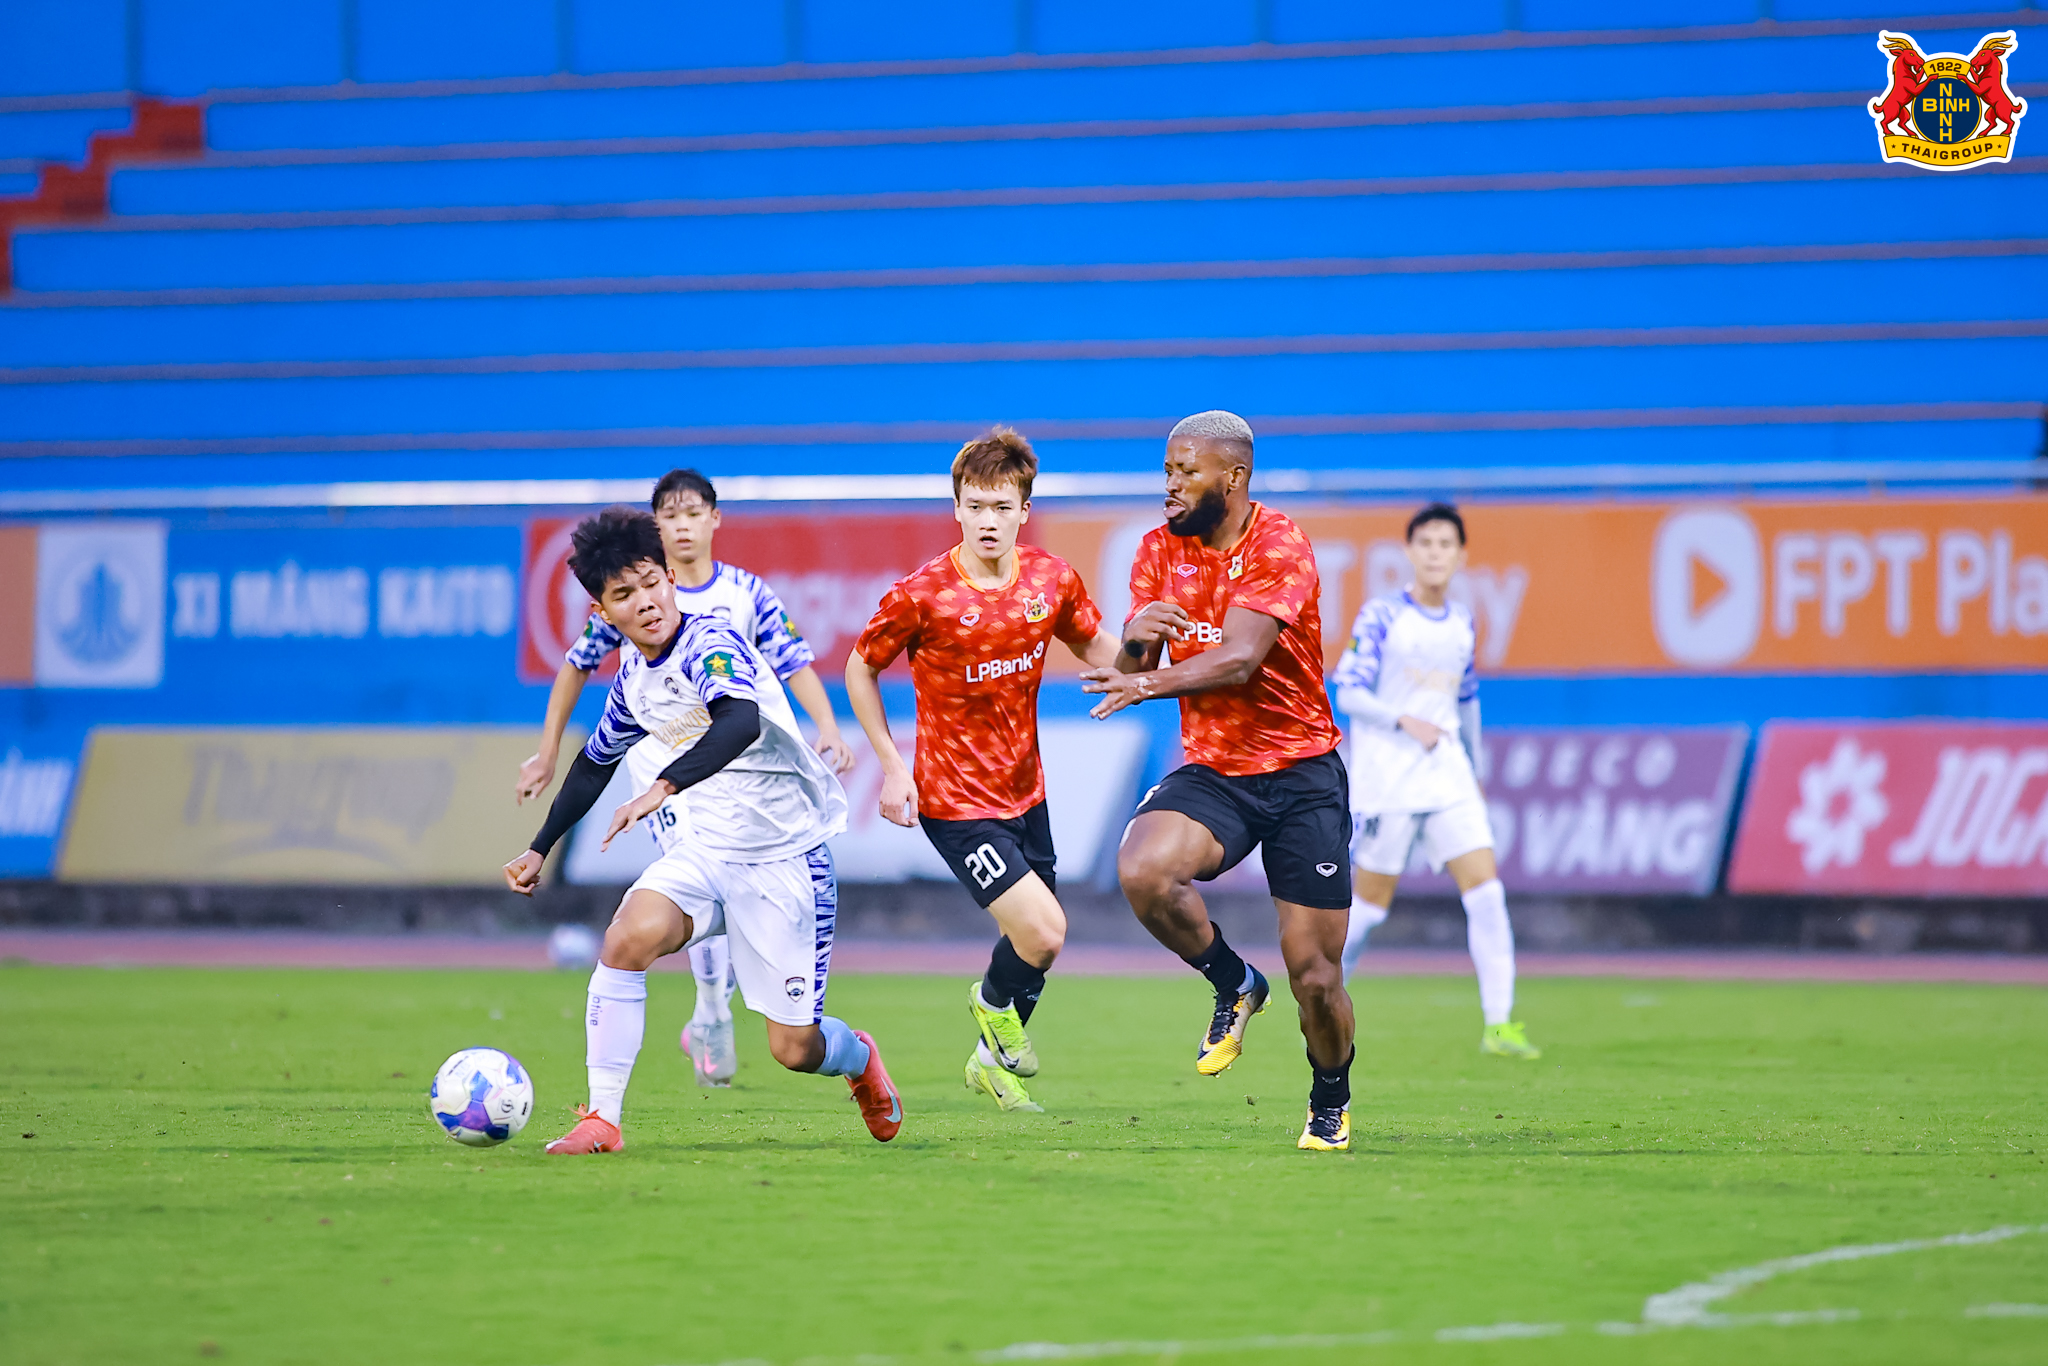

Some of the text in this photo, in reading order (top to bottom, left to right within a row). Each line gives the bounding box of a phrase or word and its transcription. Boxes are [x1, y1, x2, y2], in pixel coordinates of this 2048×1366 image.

[1773, 528, 2048, 637] FPT Pla
[965, 652, 1034, 683] LPBank
[656, 804, 677, 833] 15
[1891, 748, 2048, 866] JOG
[964, 842, 1008, 891] 20
